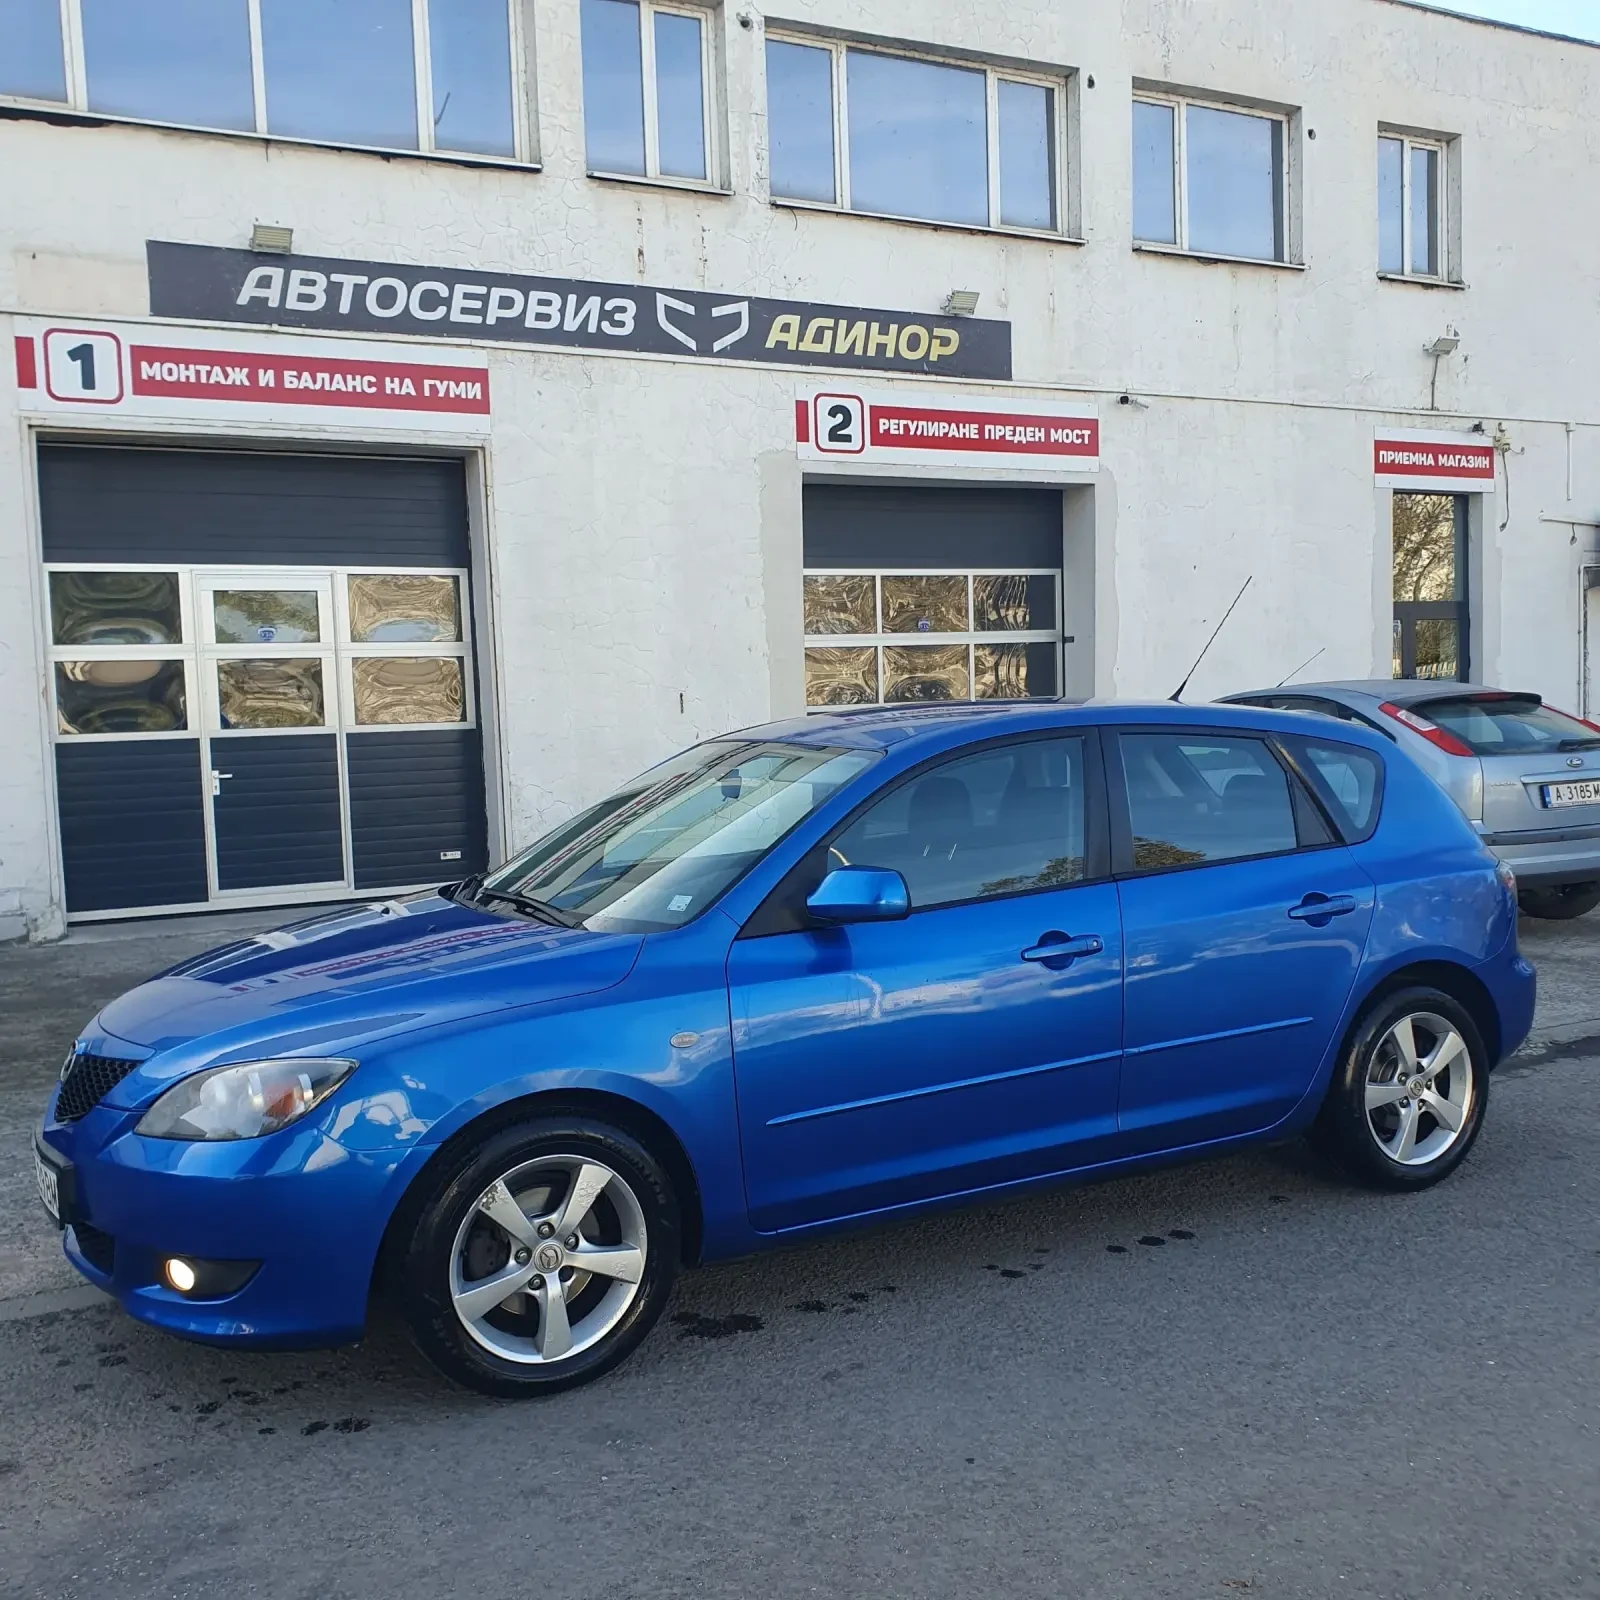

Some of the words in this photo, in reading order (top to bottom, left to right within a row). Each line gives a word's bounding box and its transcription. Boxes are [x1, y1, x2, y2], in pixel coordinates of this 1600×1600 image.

[236, 266, 637, 336] АВТОСЕРВИЗ
[765, 314, 960, 362] АДИНОР
[66, 343, 96, 391] 1
[139, 361, 250, 388] МОНТАЖ
[257, 368, 275, 389] И
[283, 370, 378, 394] БАЛАНС
[385, 376, 416, 397] НА
[423, 379, 482, 401] ГУМИ
[827, 404, 853, 443] 2
[878, 418, 979, 439] РЕГУЛИРАНЕ
[984, 425, 1045, 443] ПРЕДЕН
[1050, 428, 1091, 445] МОСТ
[1379, 450, 1435, 466] ПРИЕМНА
[1438, 453, 1490, 469] МАГАЗИН
